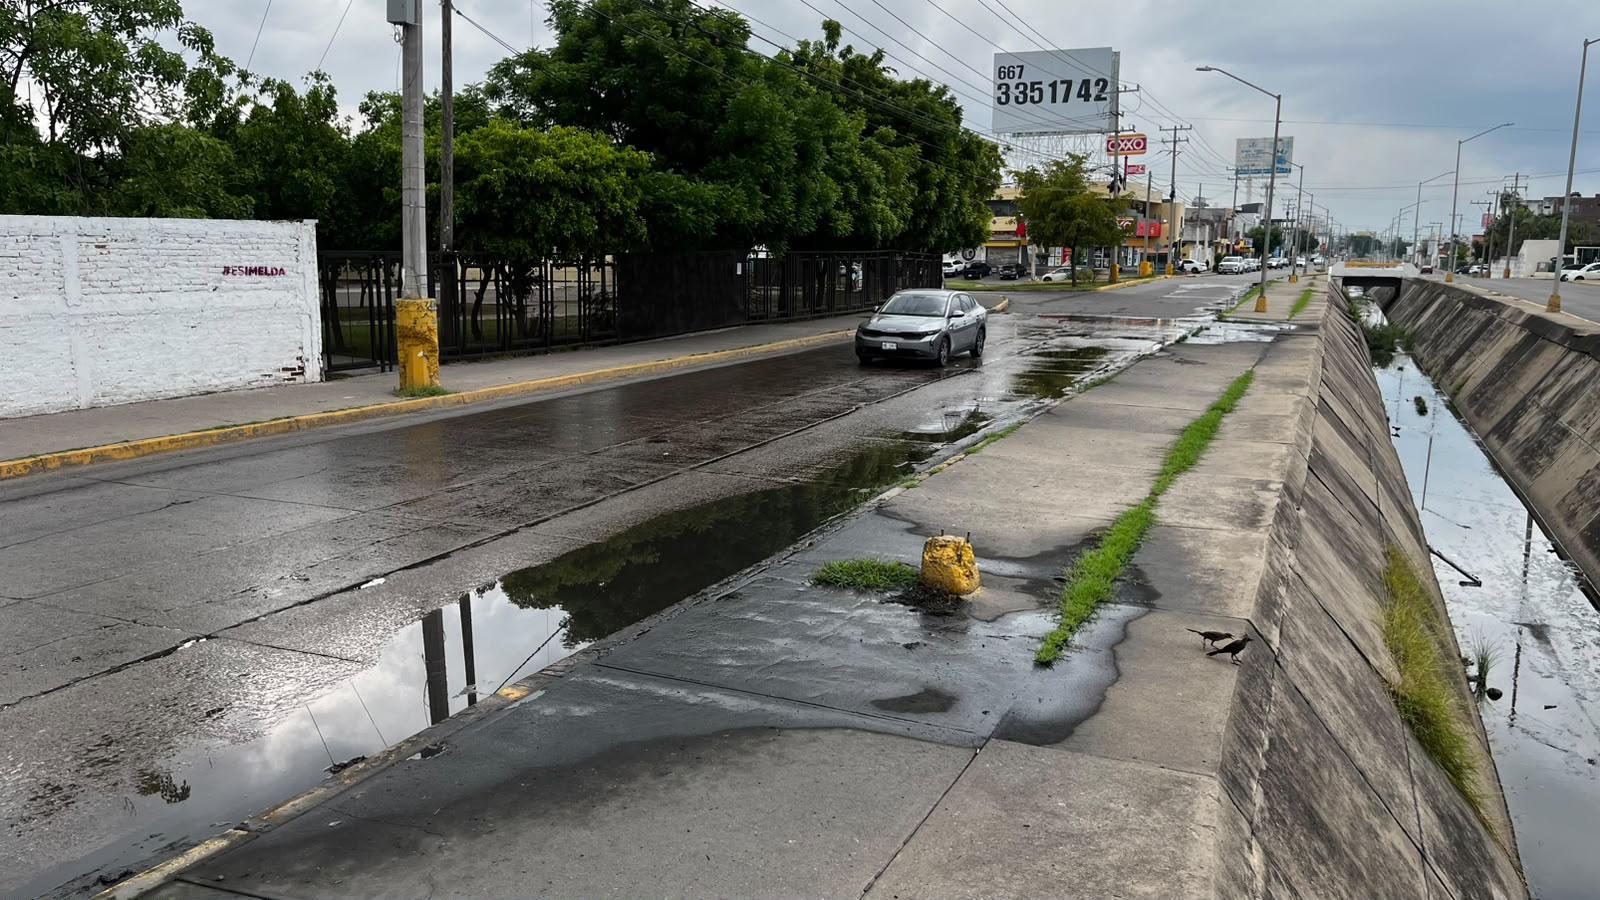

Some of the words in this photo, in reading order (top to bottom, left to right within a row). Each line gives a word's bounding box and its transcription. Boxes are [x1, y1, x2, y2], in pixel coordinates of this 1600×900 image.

[998, 65, 1025, 80] 667
[996, 78, 1109, 105] 3351742
[1108, 138, 1144, 151] OXXO
[222, 266, 286, 276] #ESIMELDA
